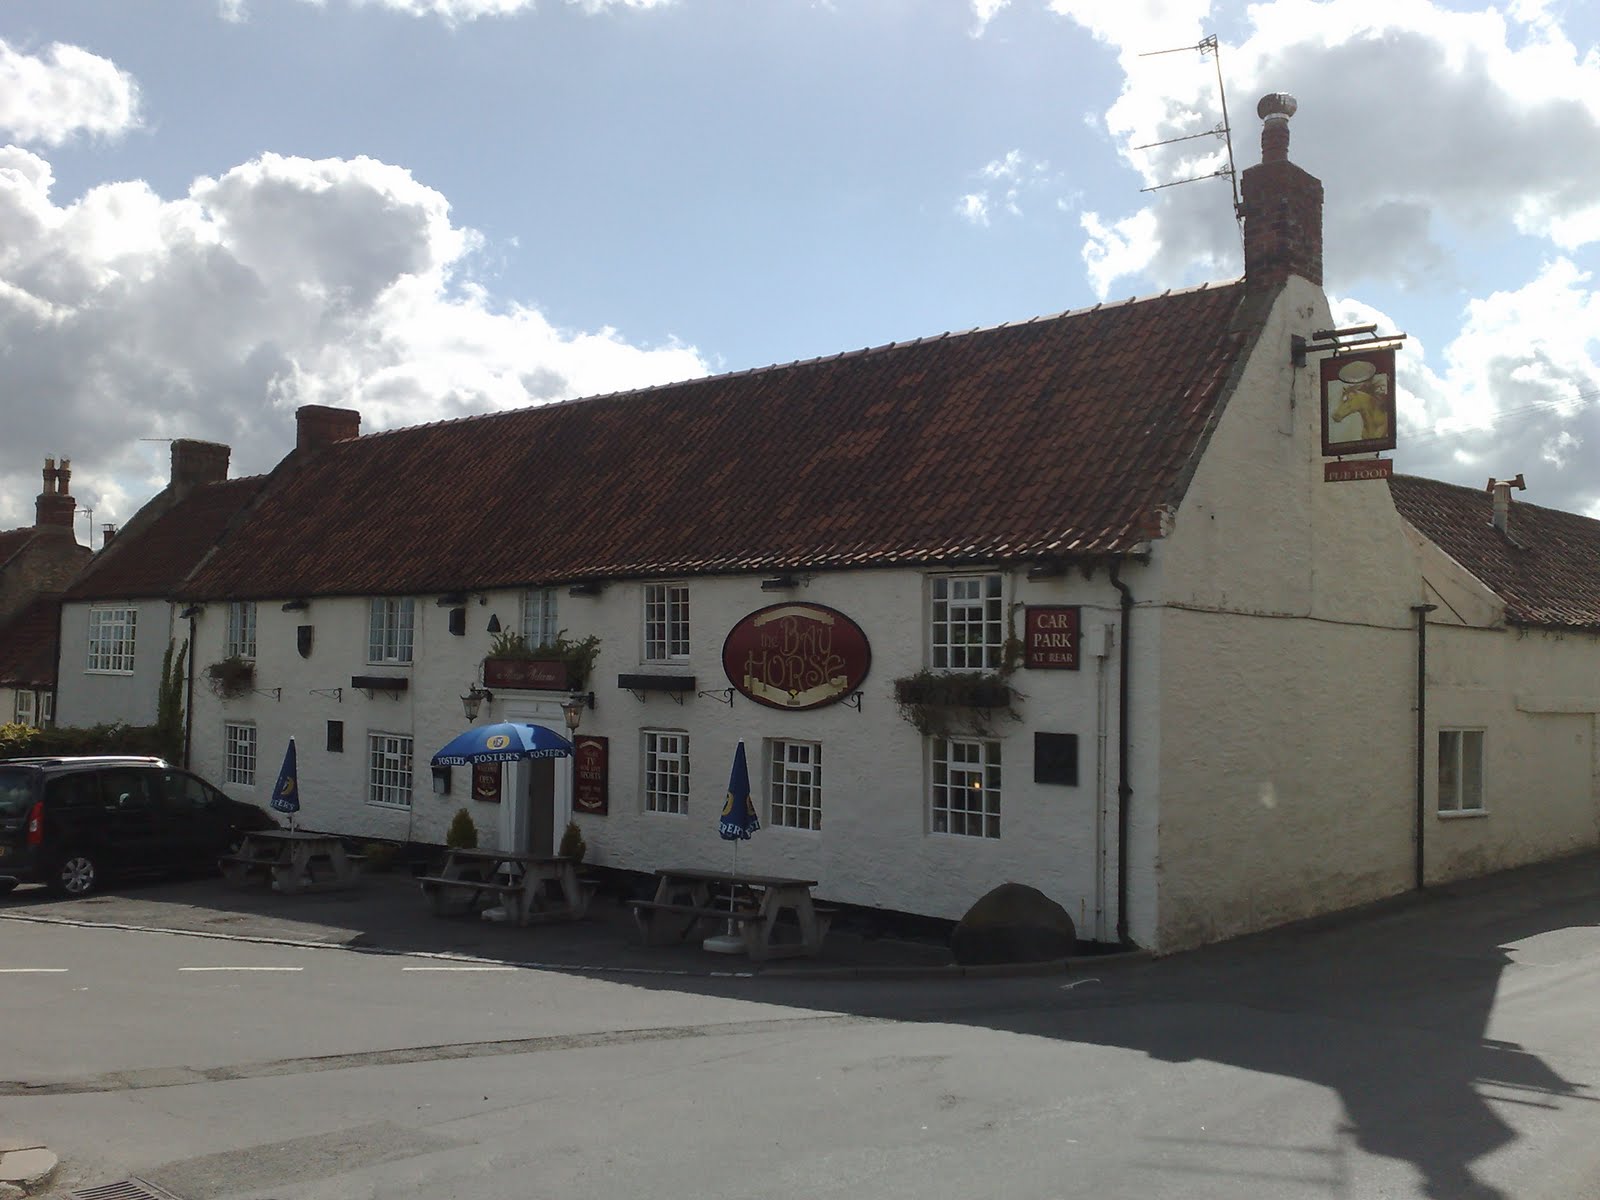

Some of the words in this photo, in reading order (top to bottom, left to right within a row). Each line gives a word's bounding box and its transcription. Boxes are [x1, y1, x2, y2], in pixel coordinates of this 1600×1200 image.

[1354, 468, 1388, 479] FOOD
[1037, 614, 1068, 628] CAR
[1034, 633, 1072, 647] PARK
[1033, 652, 1046, 662] AT
[1049, 653, 1073, 662] REAR
[744, 650, 846, 693] HORSE
[474, 752, 520, 764] FOSTER'S
